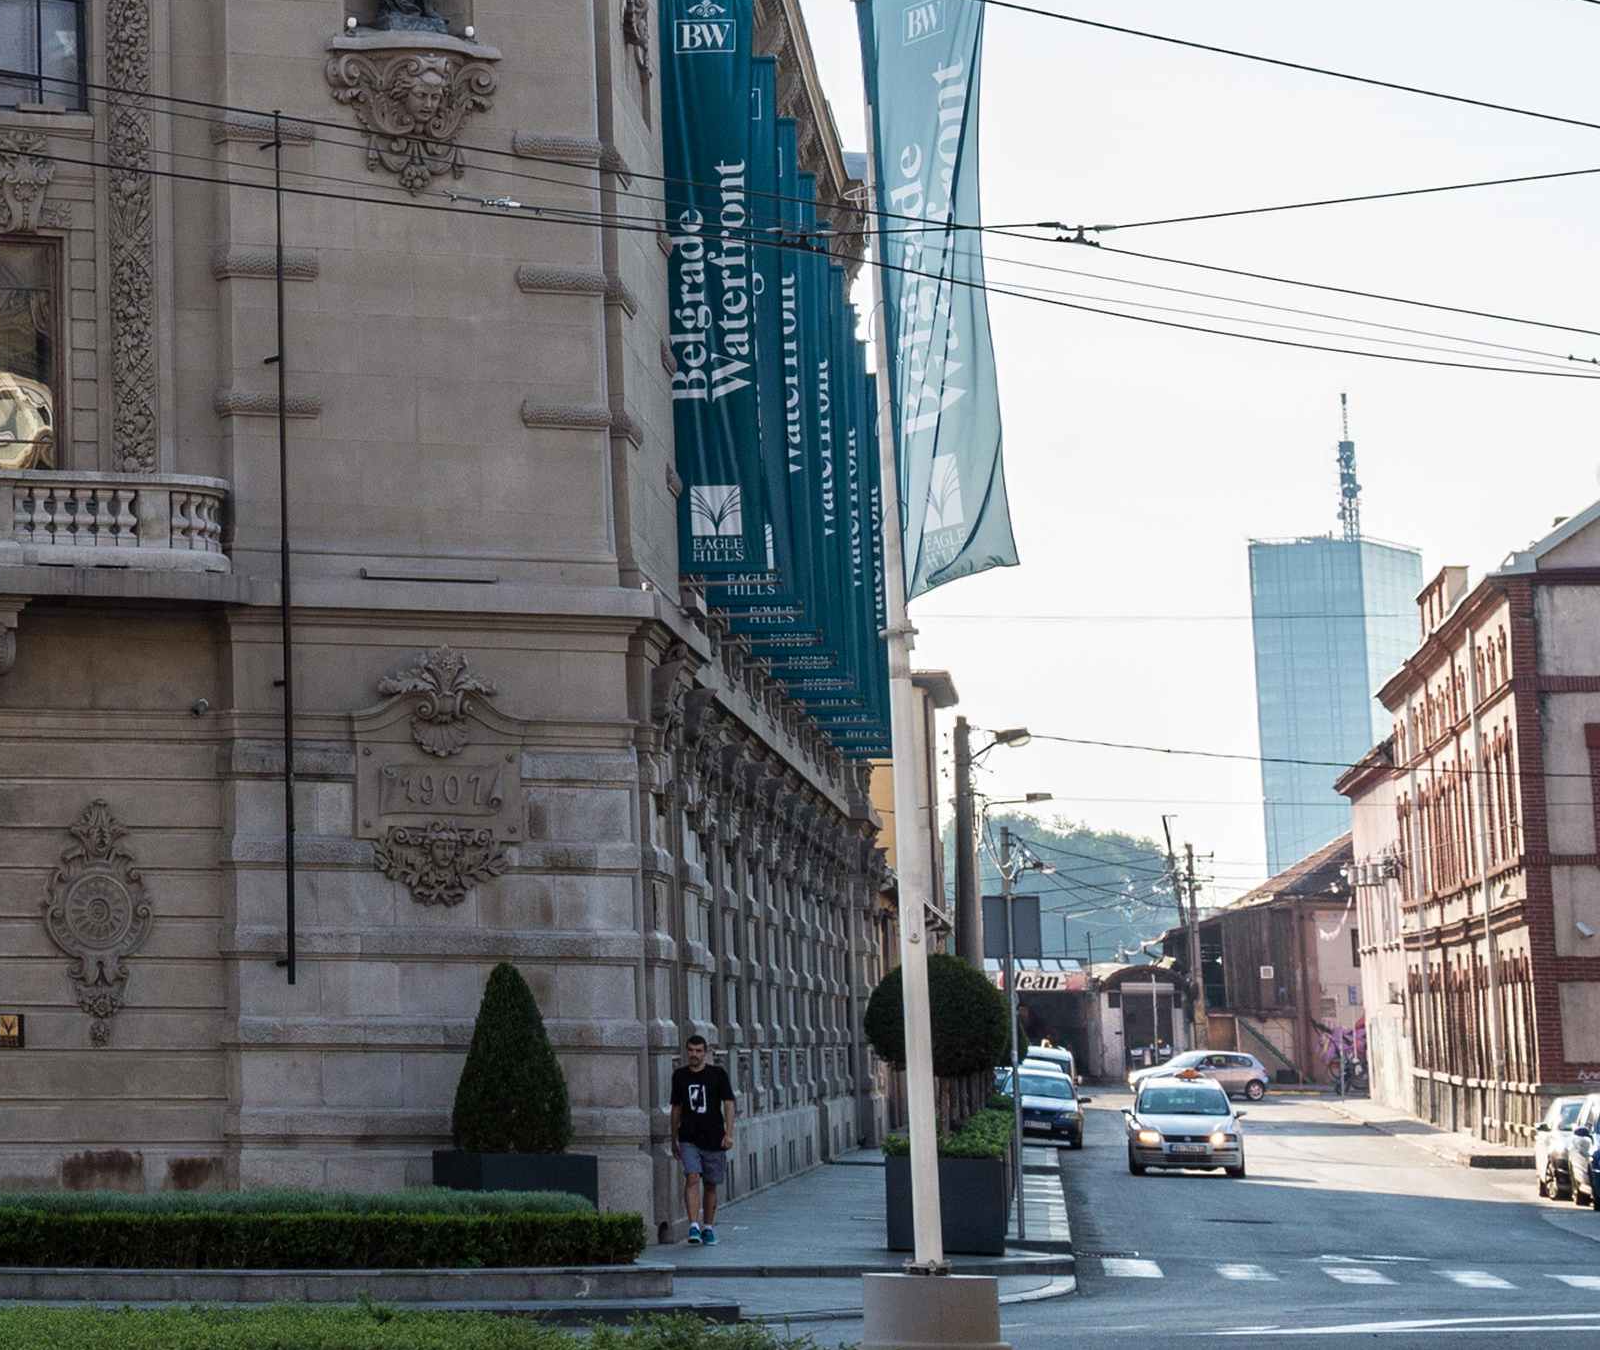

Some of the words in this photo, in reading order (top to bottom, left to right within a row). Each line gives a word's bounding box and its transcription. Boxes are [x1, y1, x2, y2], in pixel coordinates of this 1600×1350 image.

[906, 0, 942, 40] BW
[680, 23, 730, 50] BW
[707, 159, 751, 402] Waterfront
[667, 209, 712, 401] Belgrade
[693, 538, 744, 551] EAGLE
[693, 550, 745, 563] HILLS
[727, 584, 777, 596] HILLS
[999, 971, 1060, 990] lean
